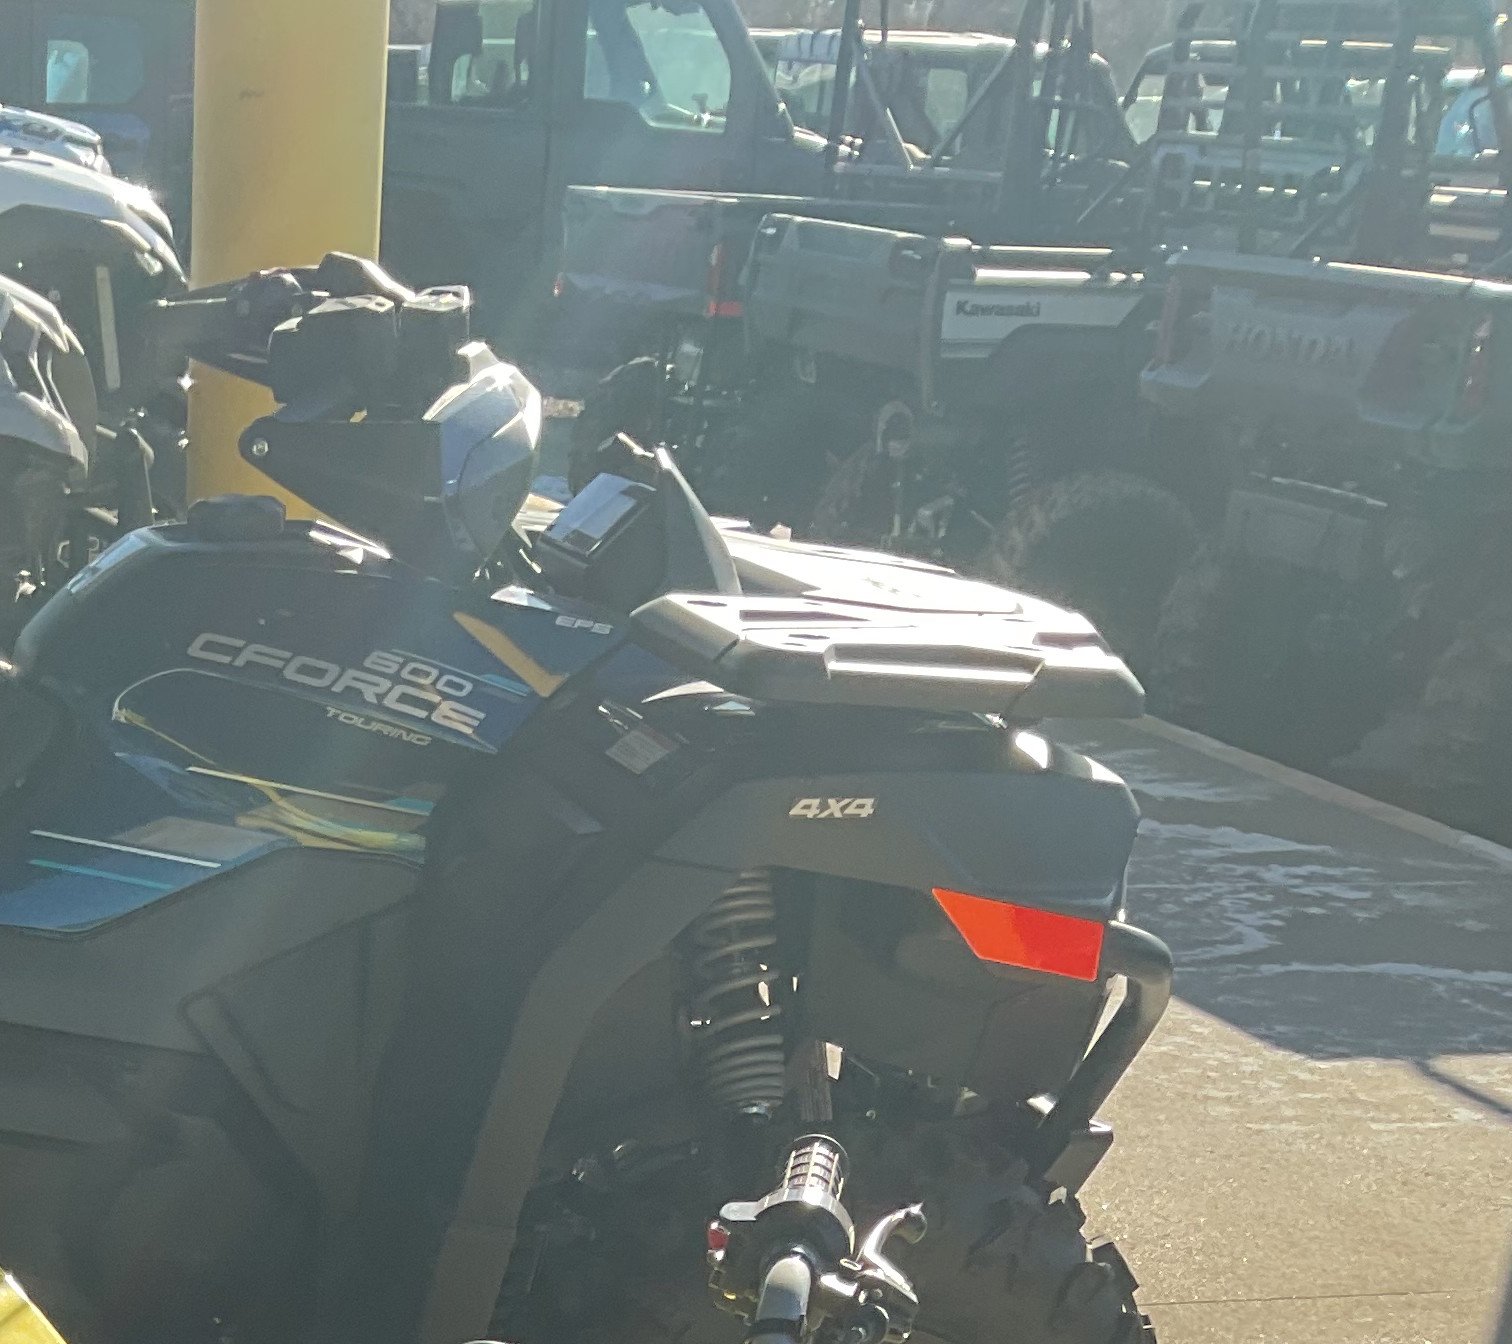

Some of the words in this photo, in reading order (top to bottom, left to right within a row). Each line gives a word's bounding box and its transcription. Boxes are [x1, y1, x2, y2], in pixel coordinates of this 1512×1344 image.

[955, 300, 1041, 318] Kawasaki
[187, 632, 487, 735] CFORCE
[363, 650, 473, 697] 600
[326, 705, 432, 746] TOURING
